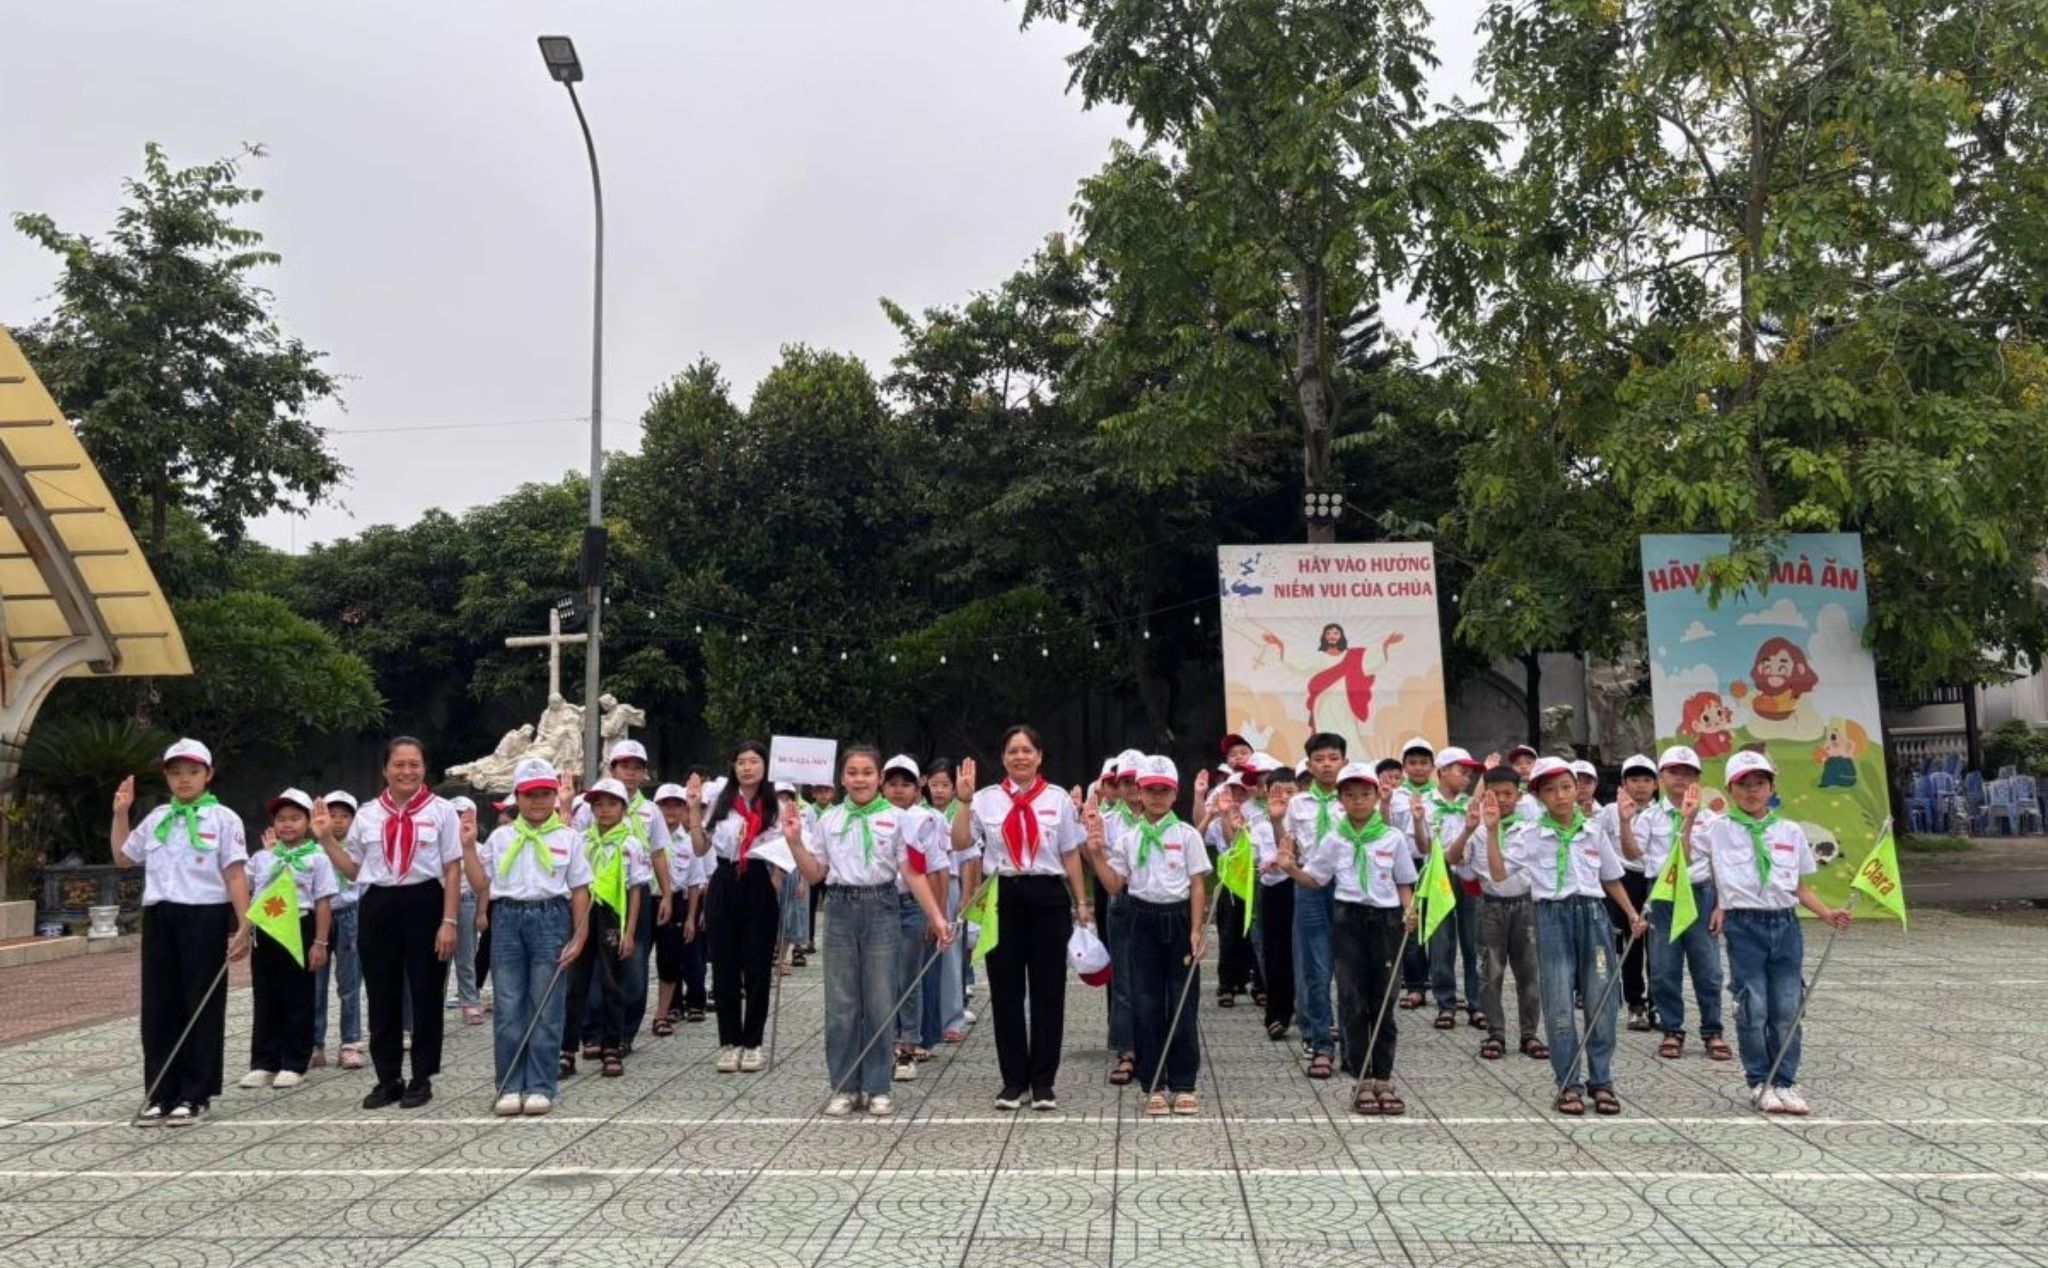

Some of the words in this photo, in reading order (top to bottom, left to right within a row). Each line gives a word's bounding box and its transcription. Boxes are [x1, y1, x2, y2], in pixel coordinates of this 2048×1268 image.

[1319, 582, 1347, 597] VUI
[1351, 578, 1383, 597] CỦA
[1648, 559, 1700, 593] HÃY
[1770, 554, 1814, 585] MÀ
[1820, 556, 1859, 592] ĂN
[1862, 858, 1896, 896] Clara
